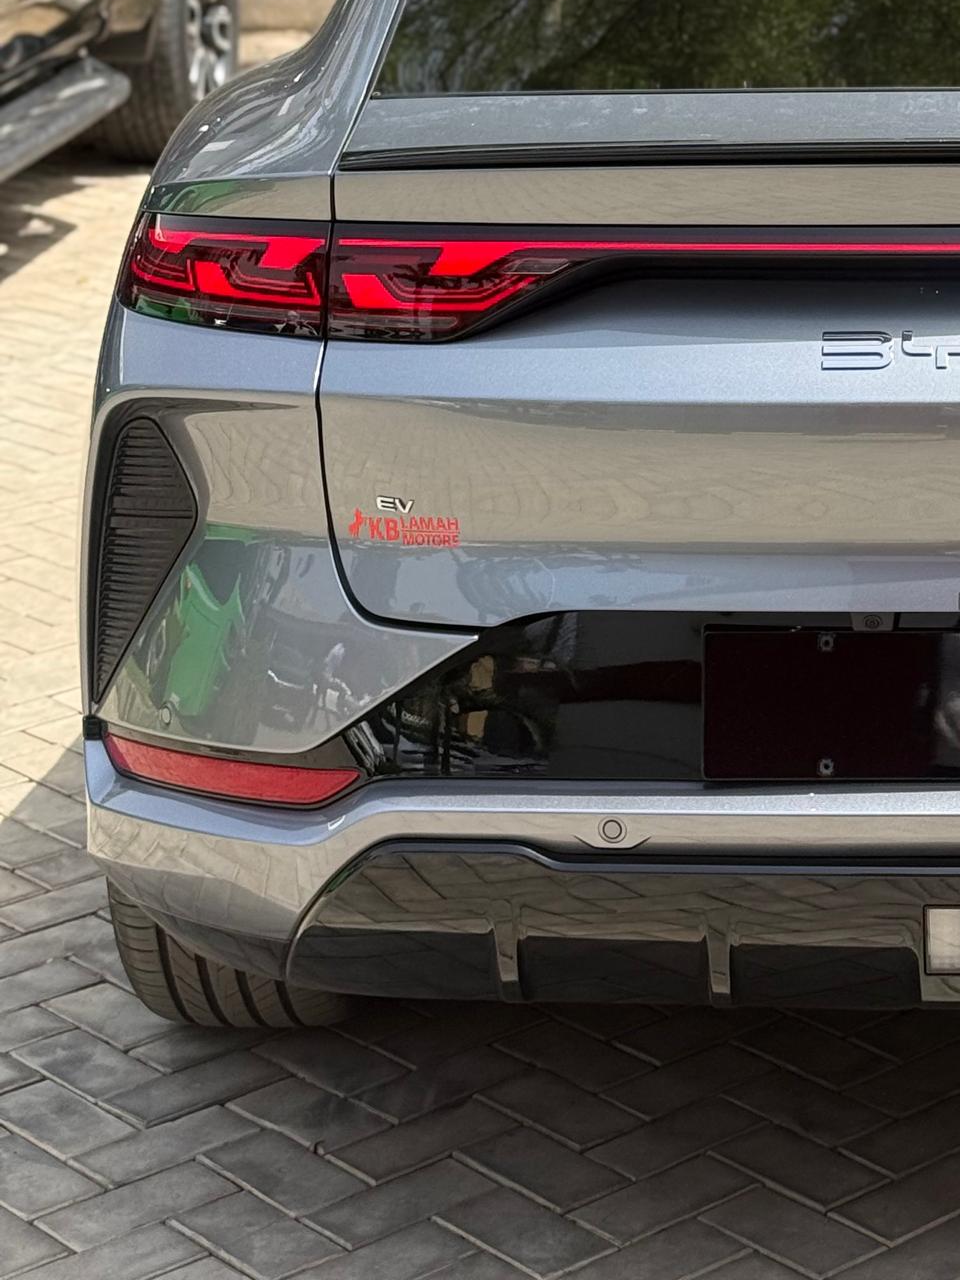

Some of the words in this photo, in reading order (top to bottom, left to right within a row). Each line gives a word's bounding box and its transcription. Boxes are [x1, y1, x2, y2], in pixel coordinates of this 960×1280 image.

[376, 495, 414, 513] EV
[367, 517, 400, 541] KB
[402, 533, 460, 547] MOTORS
